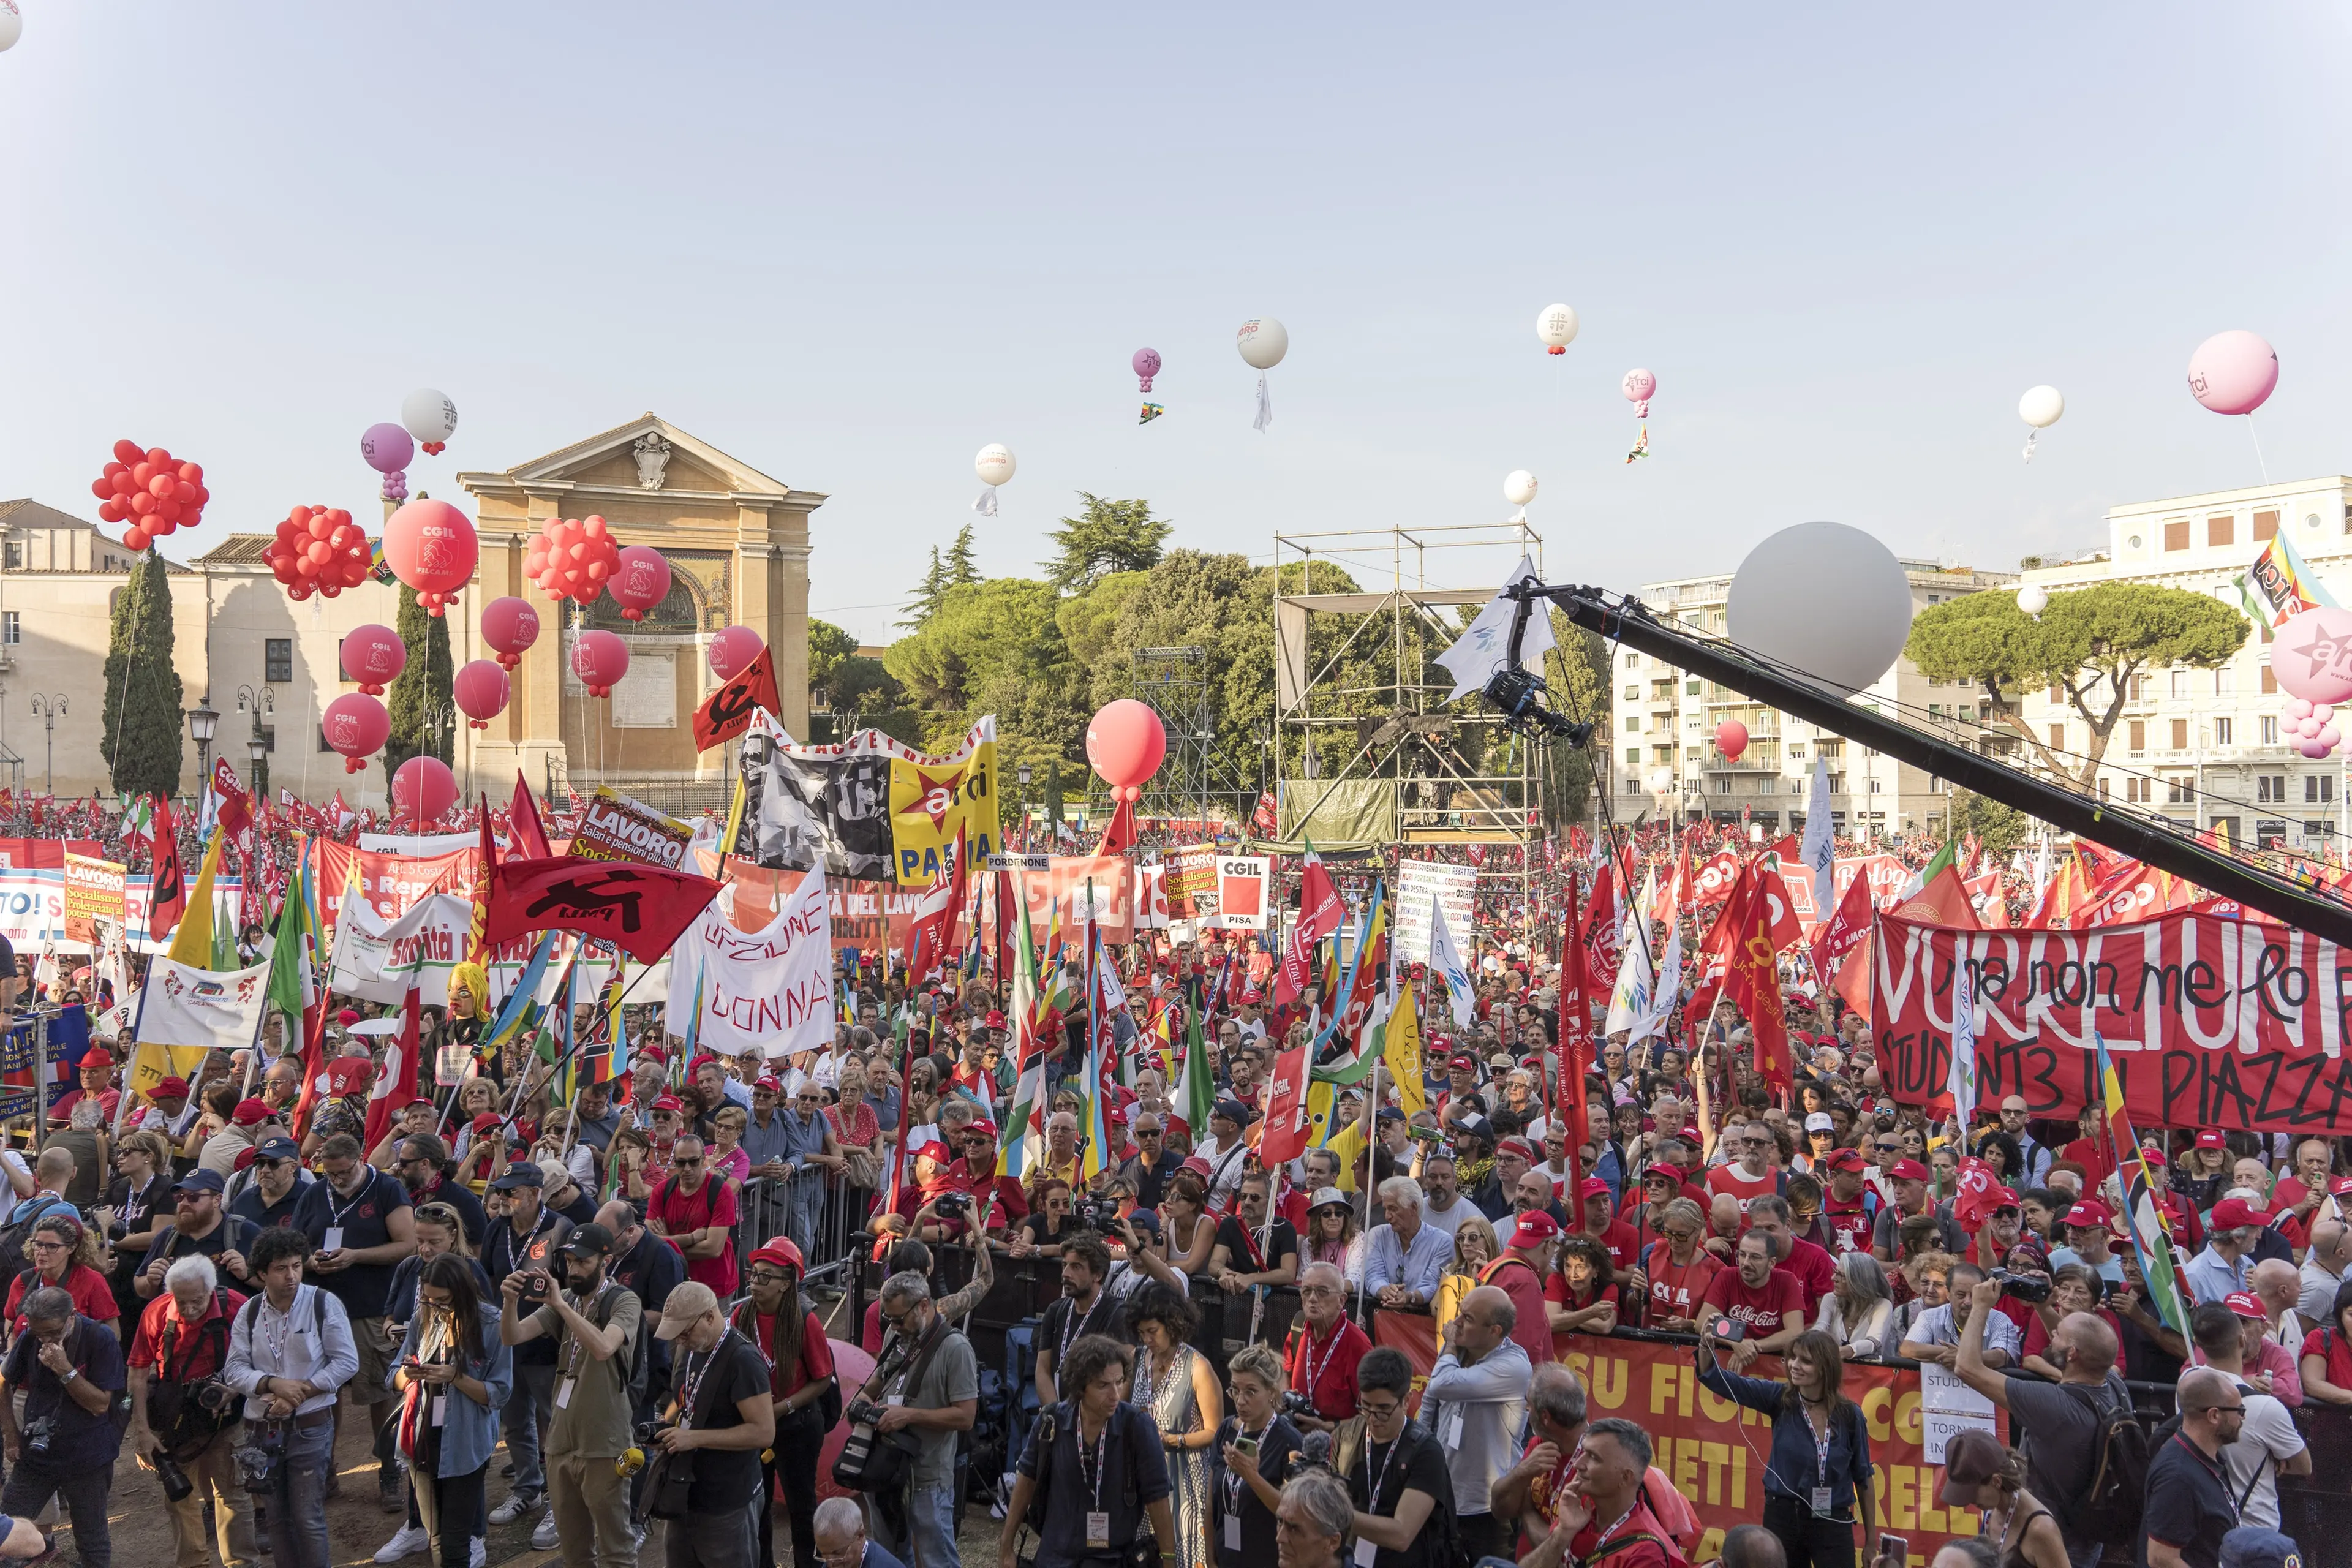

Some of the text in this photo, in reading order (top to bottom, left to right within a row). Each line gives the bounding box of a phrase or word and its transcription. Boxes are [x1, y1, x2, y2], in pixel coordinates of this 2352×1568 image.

[2190, 372, 2208, 393] rci
[362, 440, 374, 454] rci
[422, 526, 456, 539] CGIL
[417, 567, 454, 577] FILCAMS
[631, 560, 654, 571] CGIL
[624, 589, 652, 598] FILCAMS
[519, 612, 537, 622] CGIL
[372, 642, 391, 652] CGIL
[366, 665, 388, 674] FILCAMS
[335, 714, 357, 725] CGIL
[219, 766, 244, 794] CGIL
[586, 803, 682, 859] LAVORO
[582, 824, 605, 843] Salari
[611, 837, 647, 861] pensioni
[646, 850, 661, 864] più
[661, 854, 677, 869] alti
[901, 834, 993, 878] PAA
[1166, 853, 1216, 869] LAVORO
[387, 863, 415, 874] Art. 5
[1224, 862, 1262, 876] CGIL
[1401, 861, 1417, 870] QUESTO
[1418, 864, 1438, 873] GOVERNO
[1452, 867, 1477, 877] ABBATTERE
[67, 865, 124, 888] LAVORO
[1167, 871, 1215, 886] Socialismo
[1444, 877, 1476, 888] COSTITUZIONE
[67, 886, 123, 905] Socialismo
[1168, 883, 1210, 895] Proletariato
[1410, 885, 1428, 895] DESTRA
[1456, 889, 1475, 900] ODIATO
[847, 894, 880, 915] DEL
[884, 894, 924, 914] LAVO
[1168, 892, 1191, 905] potere
[1444, 900, 1474, 911] COSTITUZIONE
[67, 897, 115, 914] Proletariato
[116, 906, 124, 916] al
[67, 908, 93, 920] potere
[1229, 916, 1251, 925] PISA
[350, 935, 387, 950] integrazione
[388, 922, 454, 966] sanità
[2133, 959, 2233, 1014] me
[1273, 1078, 1291, 1096] CGIL
[1274, 1116, 1286, 1128] FISAC
[2227, 1298, 2253, 1308] BENEVENTO
[2239, 1295, 2252, 1304] CGIL
[910, 1348, 921, 1362] EOS
[1649, 1362, 1772, 1428] FIO
